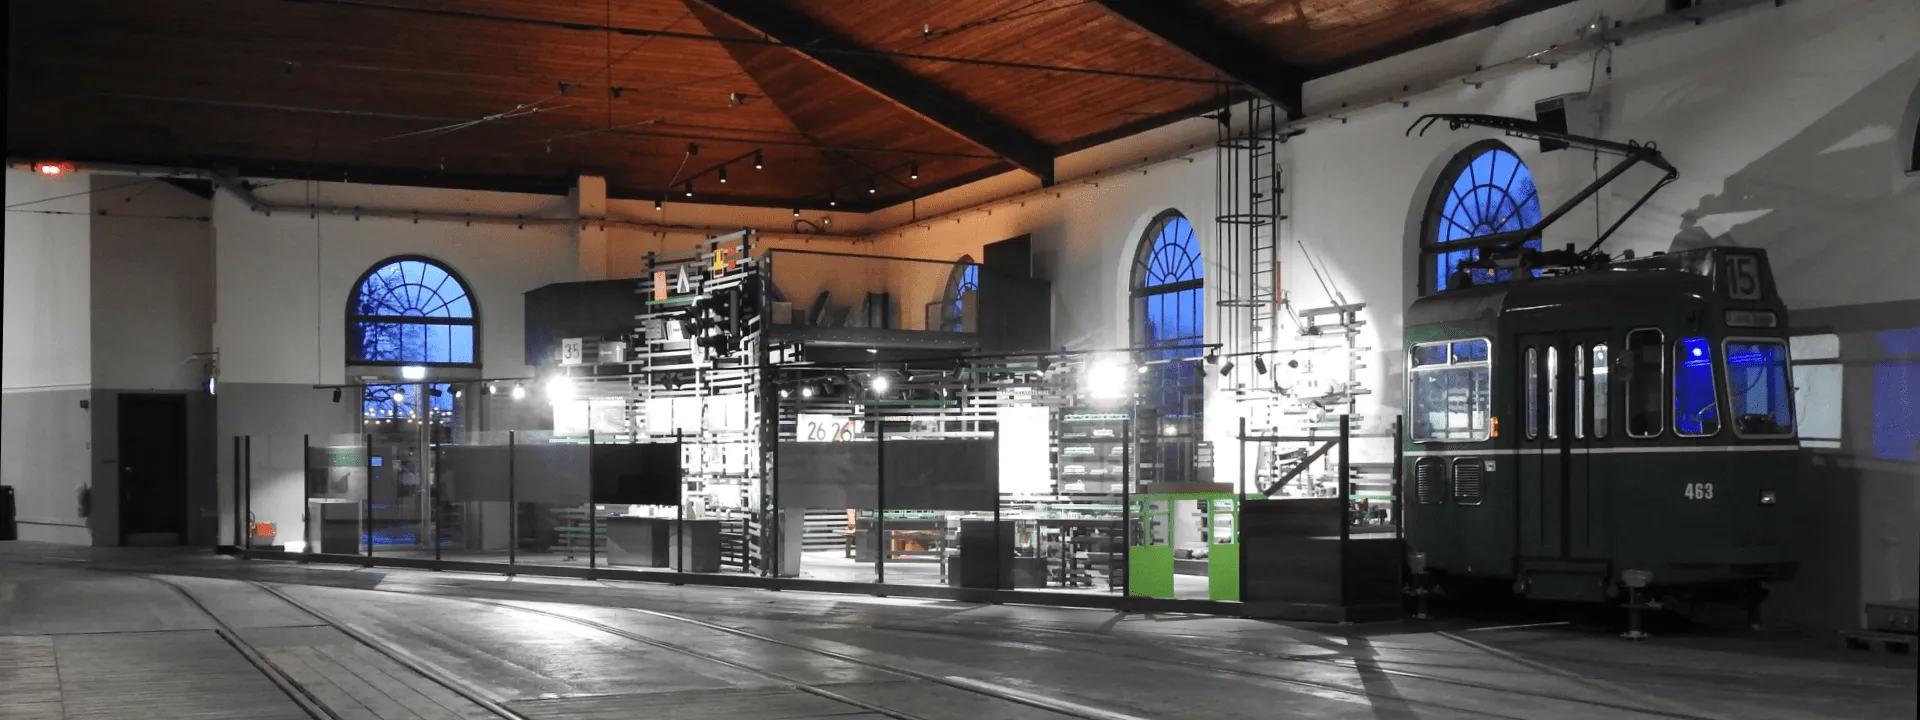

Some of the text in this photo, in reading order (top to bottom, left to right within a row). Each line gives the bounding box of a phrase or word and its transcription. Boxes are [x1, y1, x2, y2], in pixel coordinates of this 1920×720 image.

[1726, 257, 1756, 296] 15
[564, 343, 580, 359] 35
[807, 421, 826, 441] 26
[831, 421, 852, 441] 26
[1684, 482, 1714, 500] 463
